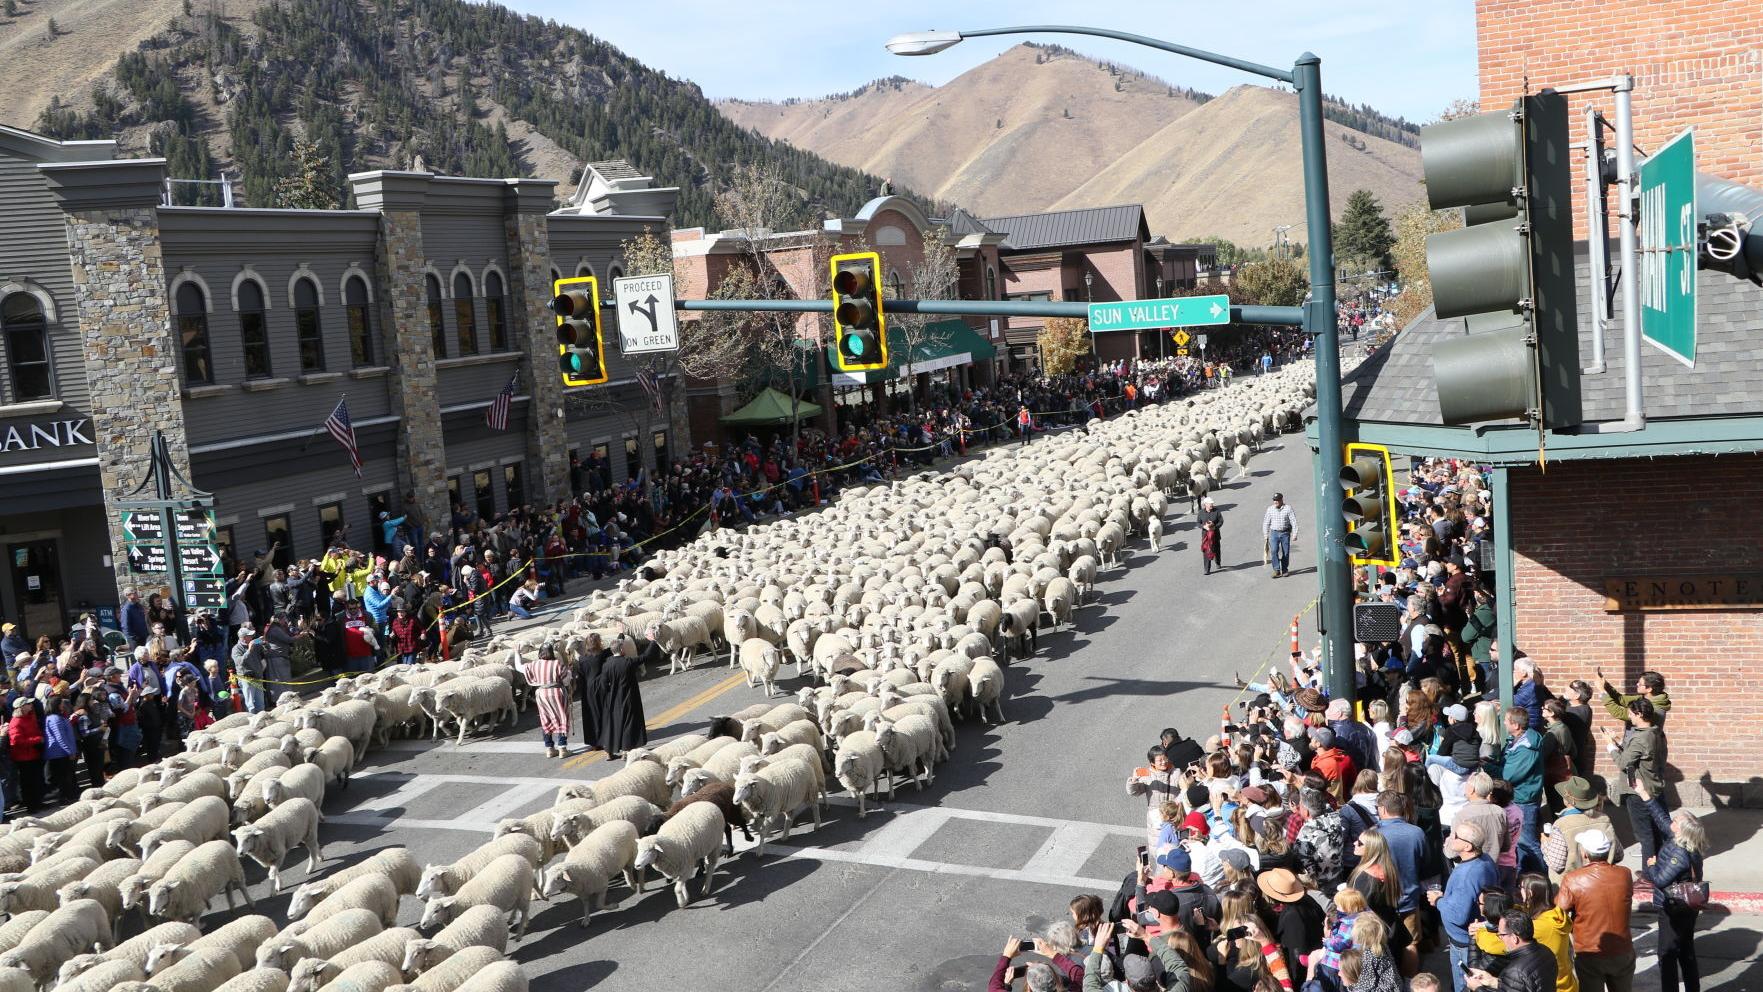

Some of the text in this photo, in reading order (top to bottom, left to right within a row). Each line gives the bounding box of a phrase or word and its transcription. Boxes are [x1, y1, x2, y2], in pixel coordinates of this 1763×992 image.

[1642, 183, 1692, 314] MAIN ST
[623, 280, 662, 293] PROCEED
[1094, 304, 1180, 325] SUN VALLEY
[626, 334, 671, 348] ON GREEN
[0, 419, 95, 453] ANK
[177, 523, 194, 532] Square
[181, 547, 205, 556] Sun Valley
[1624, 581, 1763, 597] ENOTE
